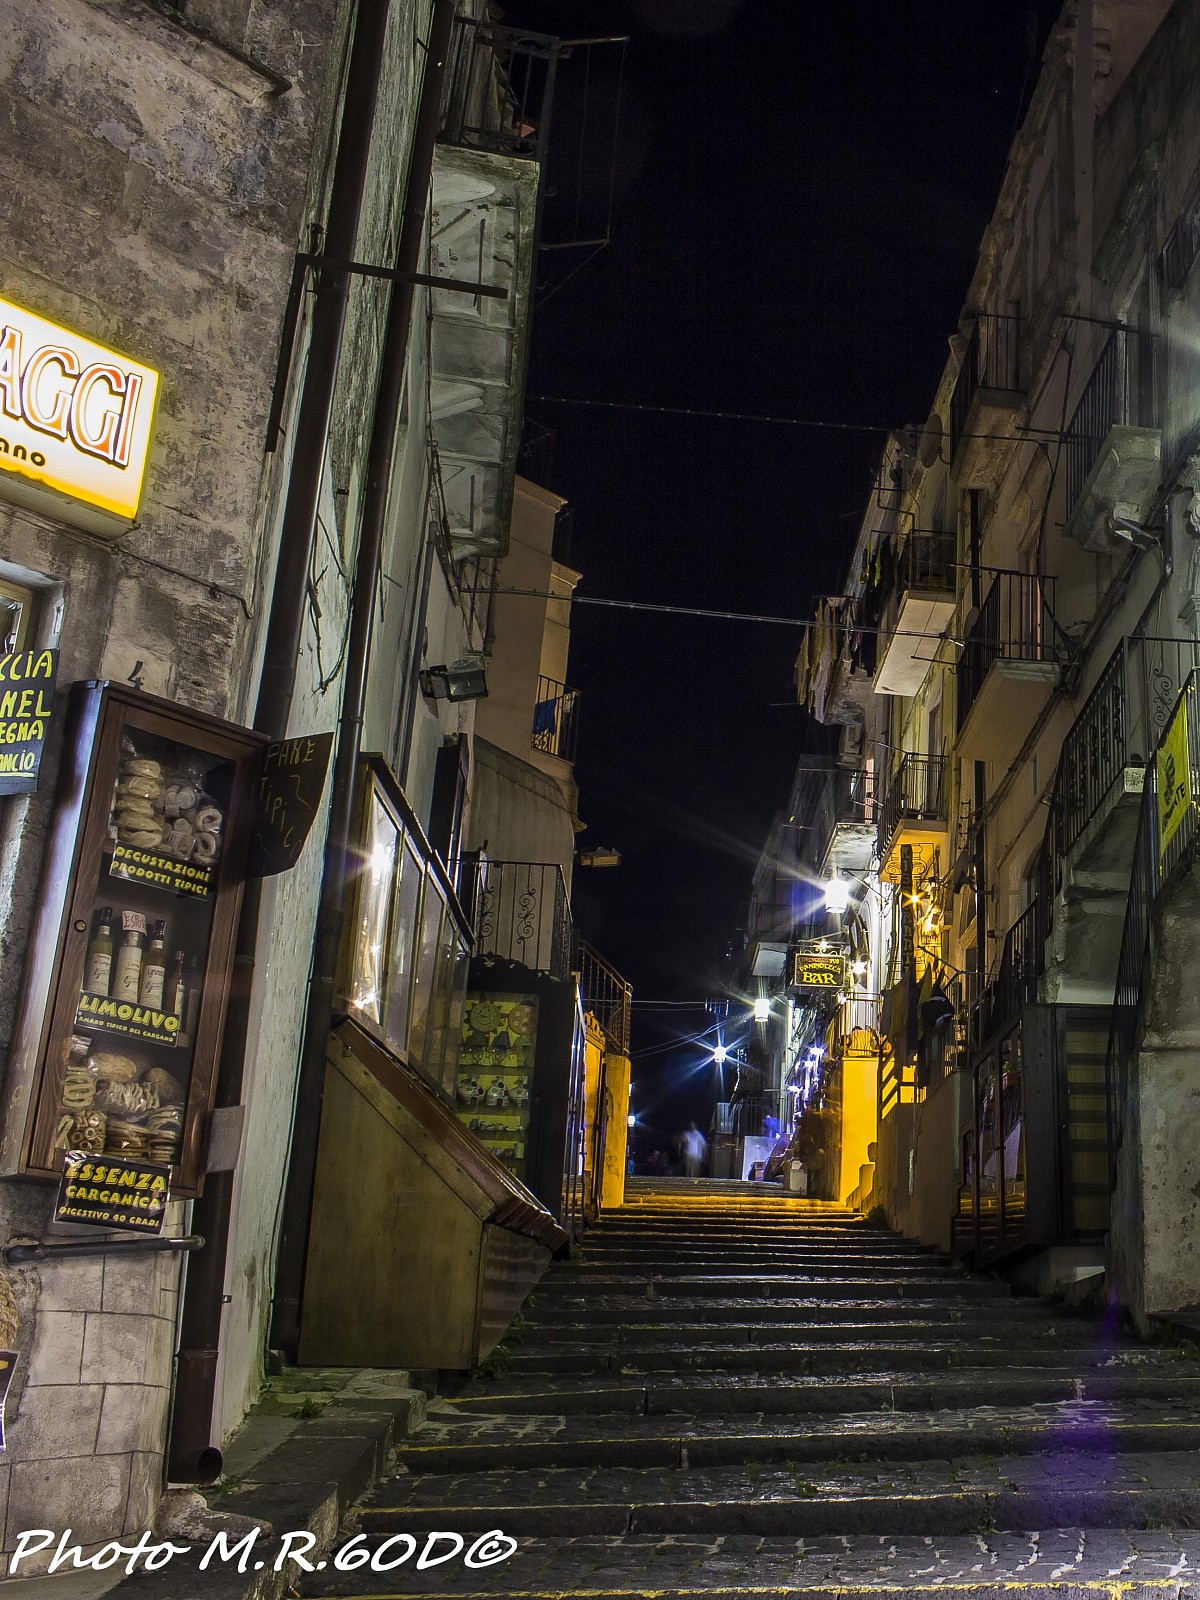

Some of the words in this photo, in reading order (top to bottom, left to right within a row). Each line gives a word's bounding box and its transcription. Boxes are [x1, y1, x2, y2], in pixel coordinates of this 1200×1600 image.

[127, 660, 145, 691] 4
[264, 739, 315, 772] PANE
[112, 861, 171, 886] PRODOTTI
[174, 878, 209, 896] TIPICI
[802, 971, 837, 985] BAR
[78, 1016, 104, 1026] AMARO
[106, 1022, 128, 1032] TIPICO
[129, 1027, 141, 1035] DEL
[79, 995, 180, 1032] LIMOLIVO
[65, 1161, 167, 1193] ESSENZA
[58, 1206, 110, 1221] DIGESTIVO
[112, 1213, 127, 1222] 40
[129, 1217, 160, 1227] GRADI
